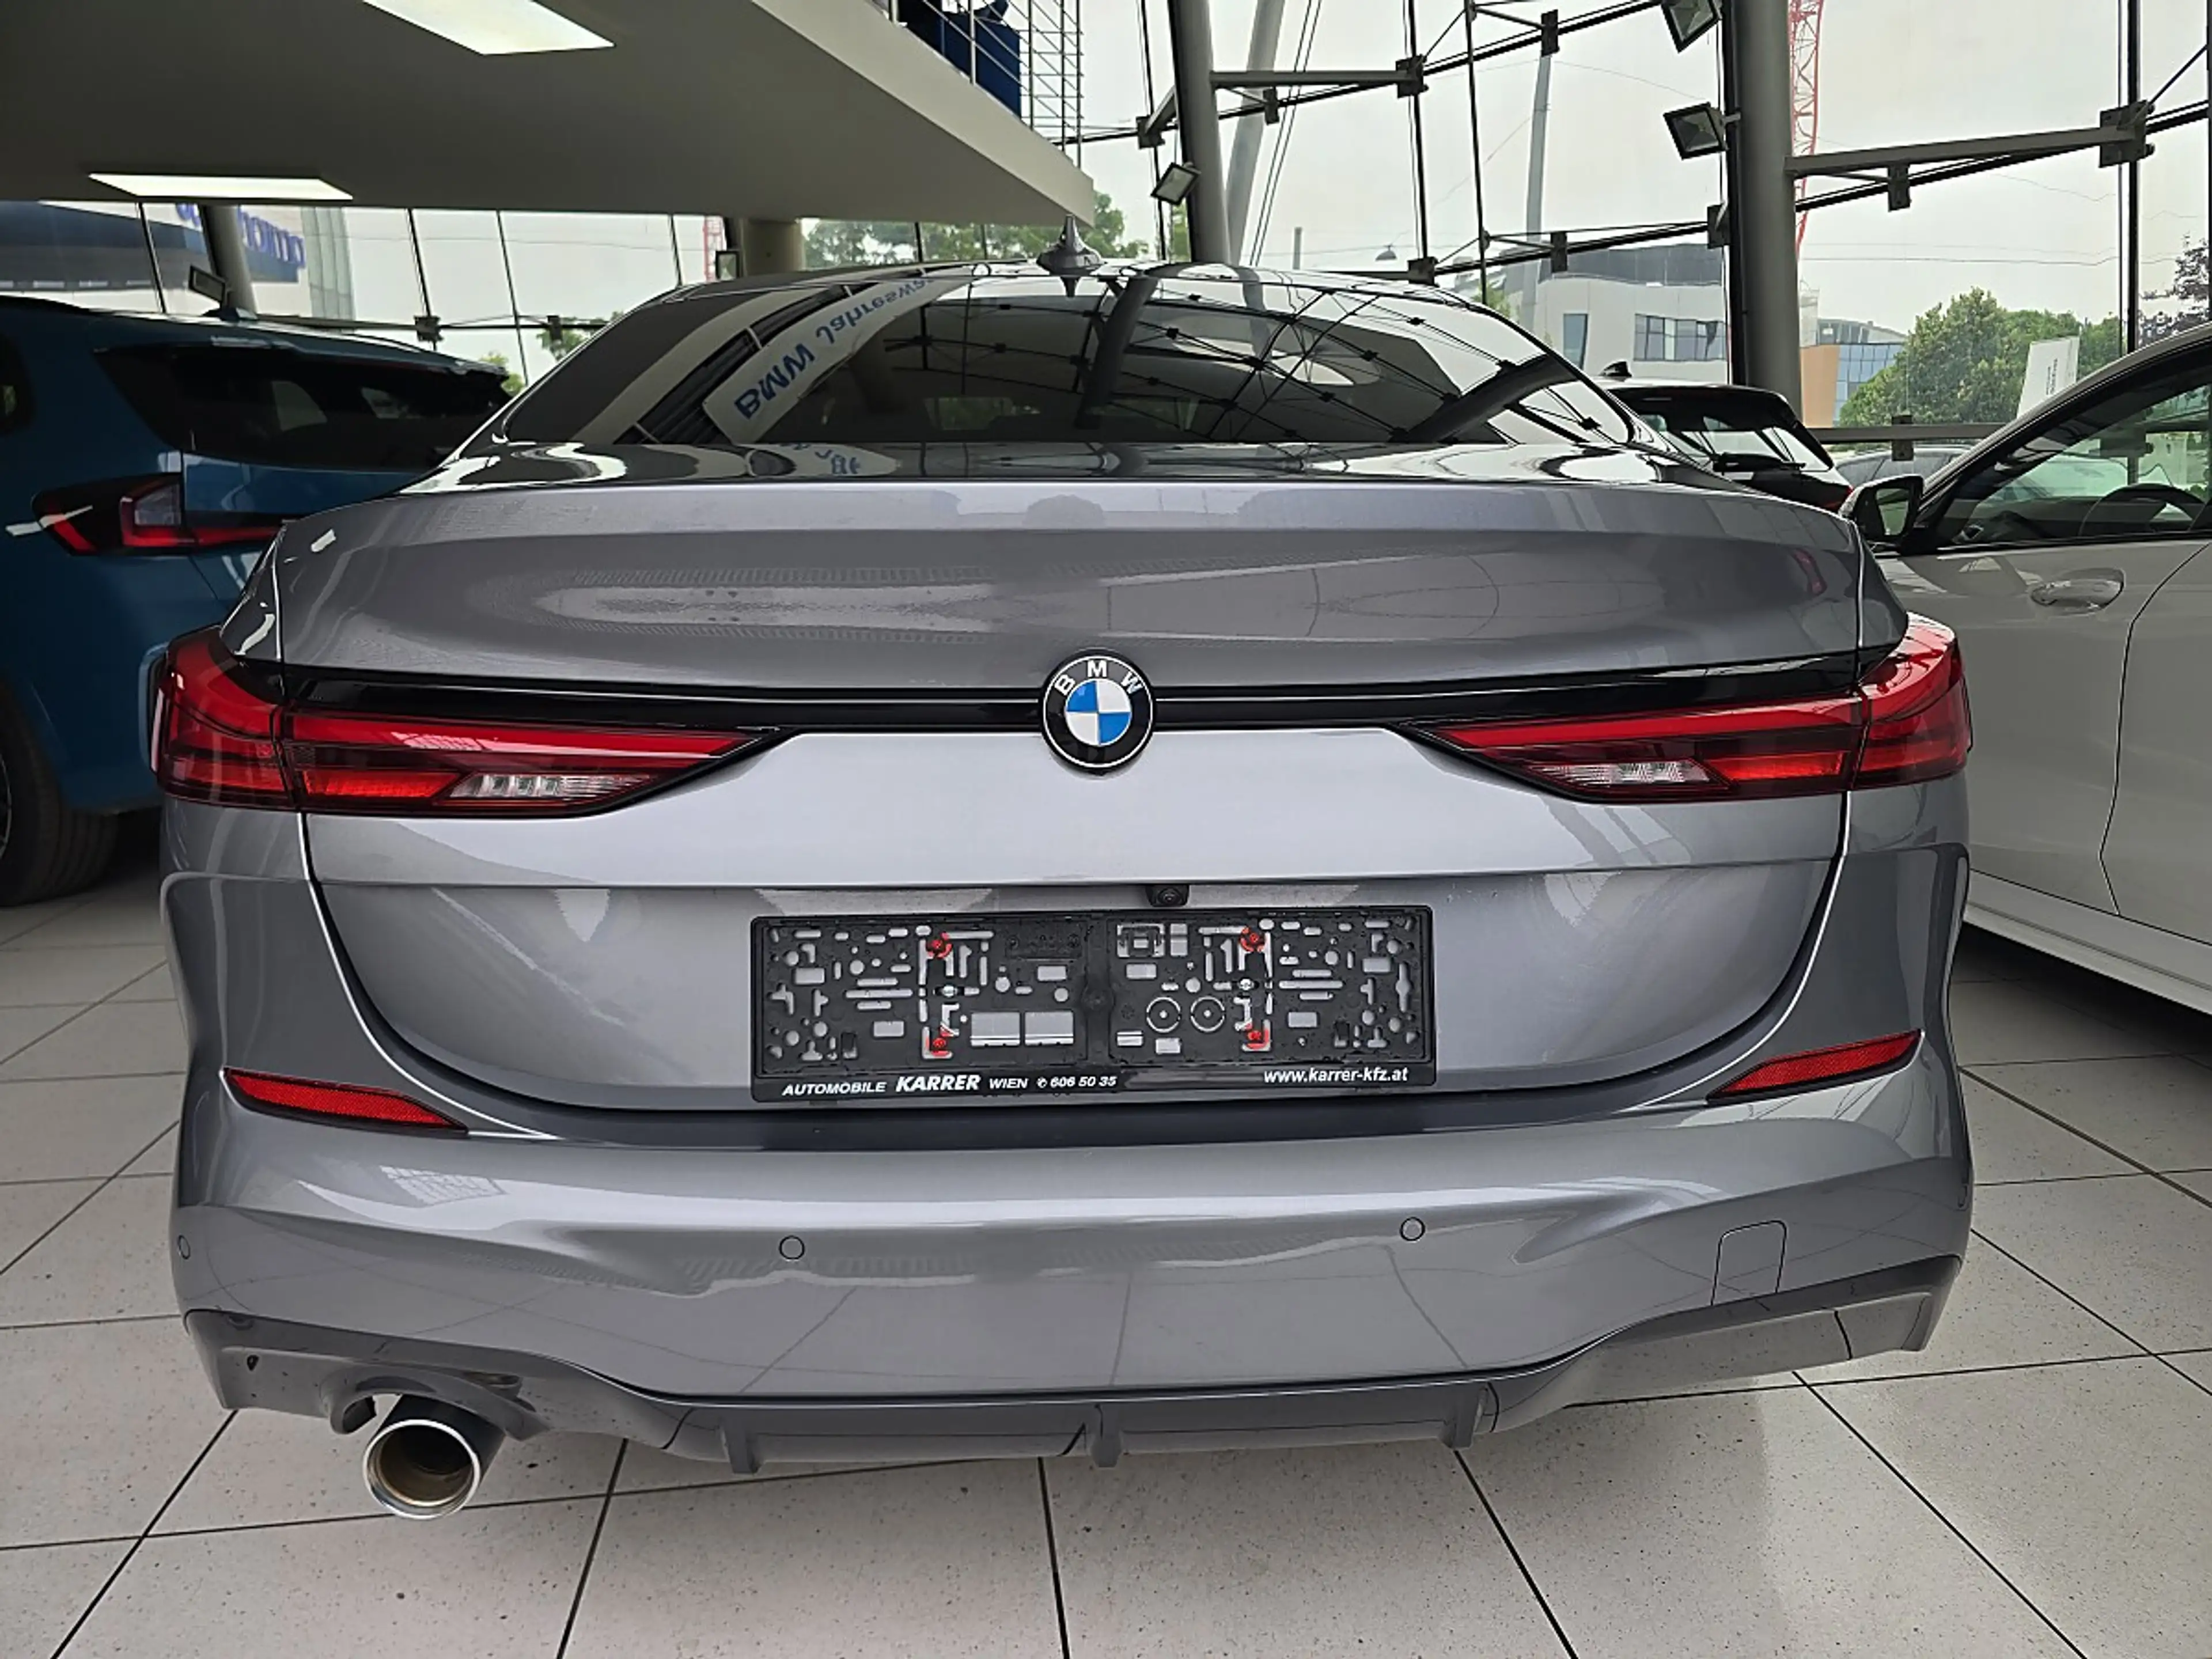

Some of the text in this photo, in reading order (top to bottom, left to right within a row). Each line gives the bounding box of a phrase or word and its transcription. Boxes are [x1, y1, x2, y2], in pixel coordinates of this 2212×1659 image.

[1055, 660, 1143, 695] BMW
[782, 1074, 1118, 1096] AUTOMOBILE KARRER WIEN 606 50 35
[1264, 1067, 1409, 1083] www.karrer-kfz.at
